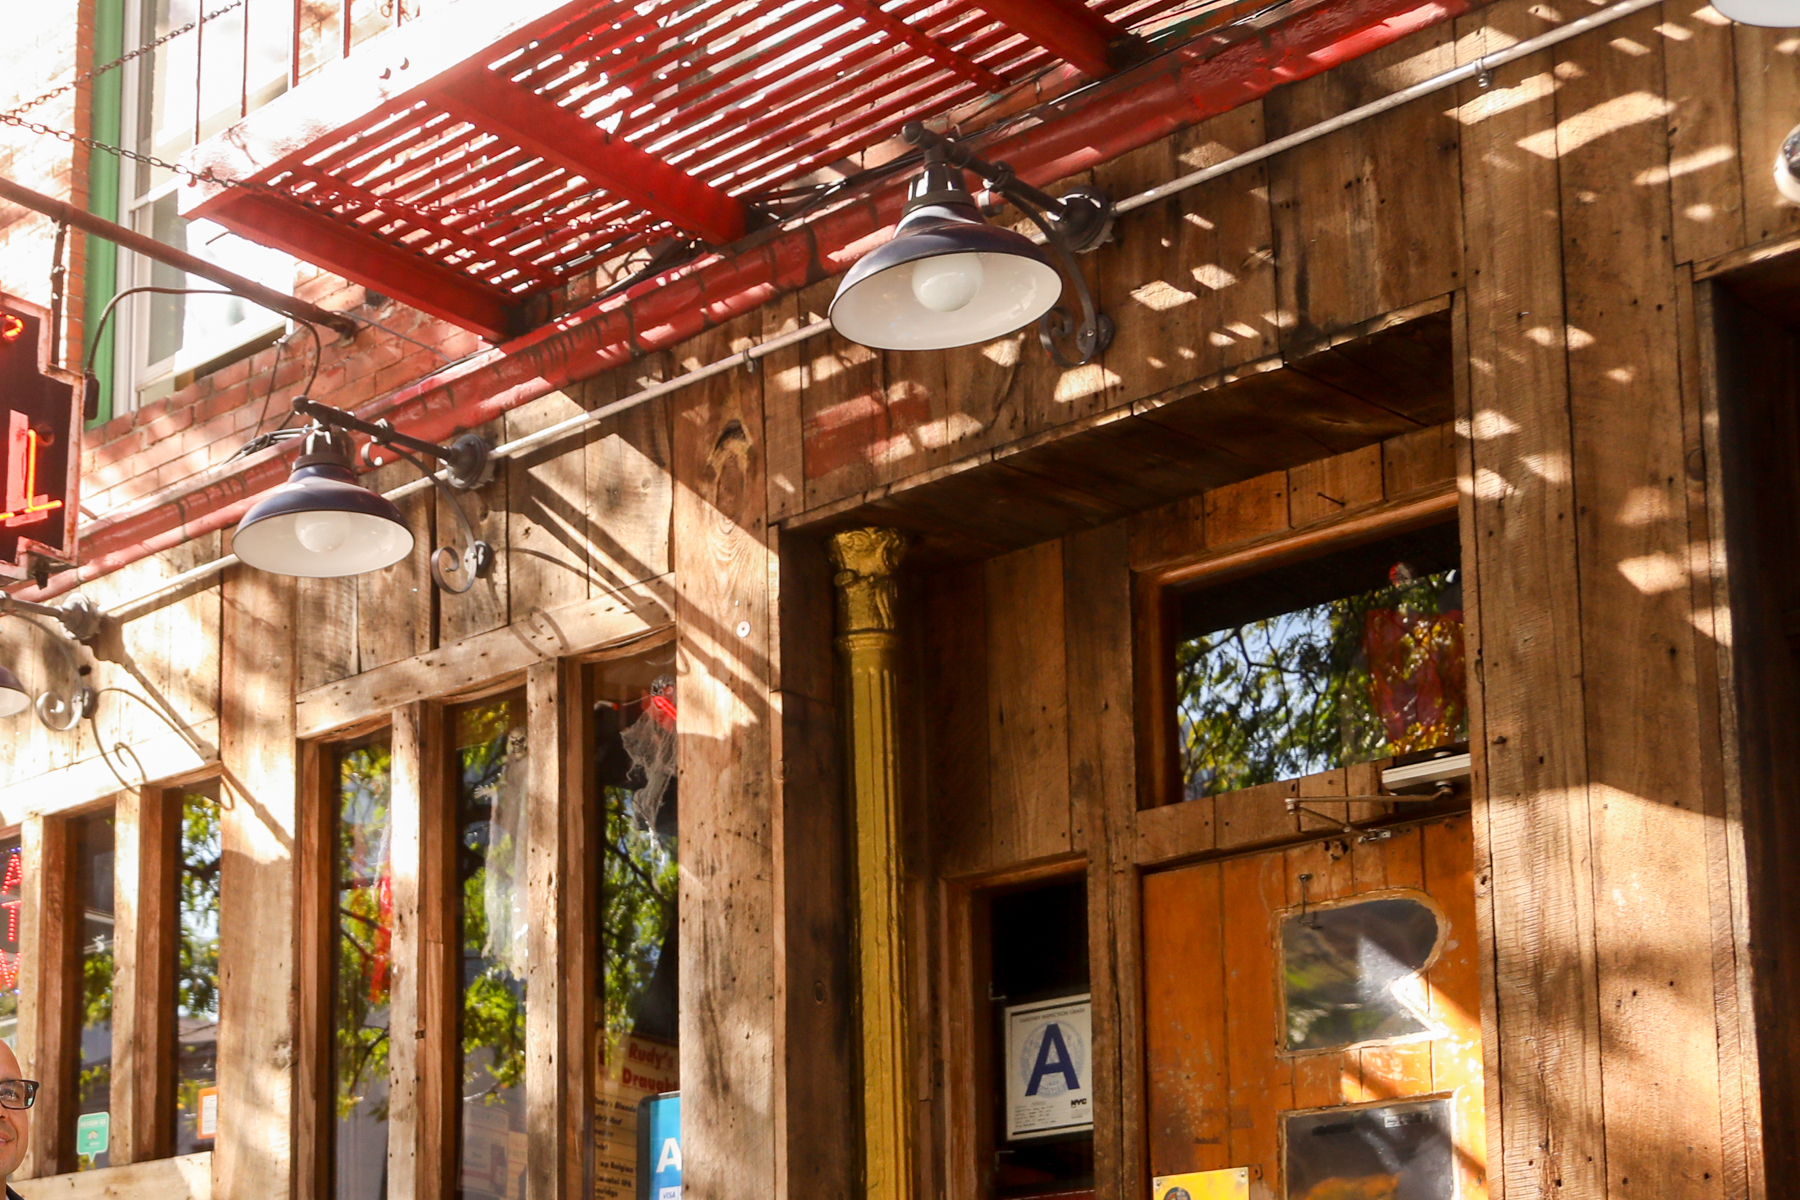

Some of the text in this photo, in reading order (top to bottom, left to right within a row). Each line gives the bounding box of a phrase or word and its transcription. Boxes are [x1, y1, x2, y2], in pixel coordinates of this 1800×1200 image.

[628, 1041, 676, 1070] Rudy's
[1025, 1023, 1080, 1097] A
[1070, 1098, 1087, 1106] NYC
[662, 1191, 676, 1200] VISA
